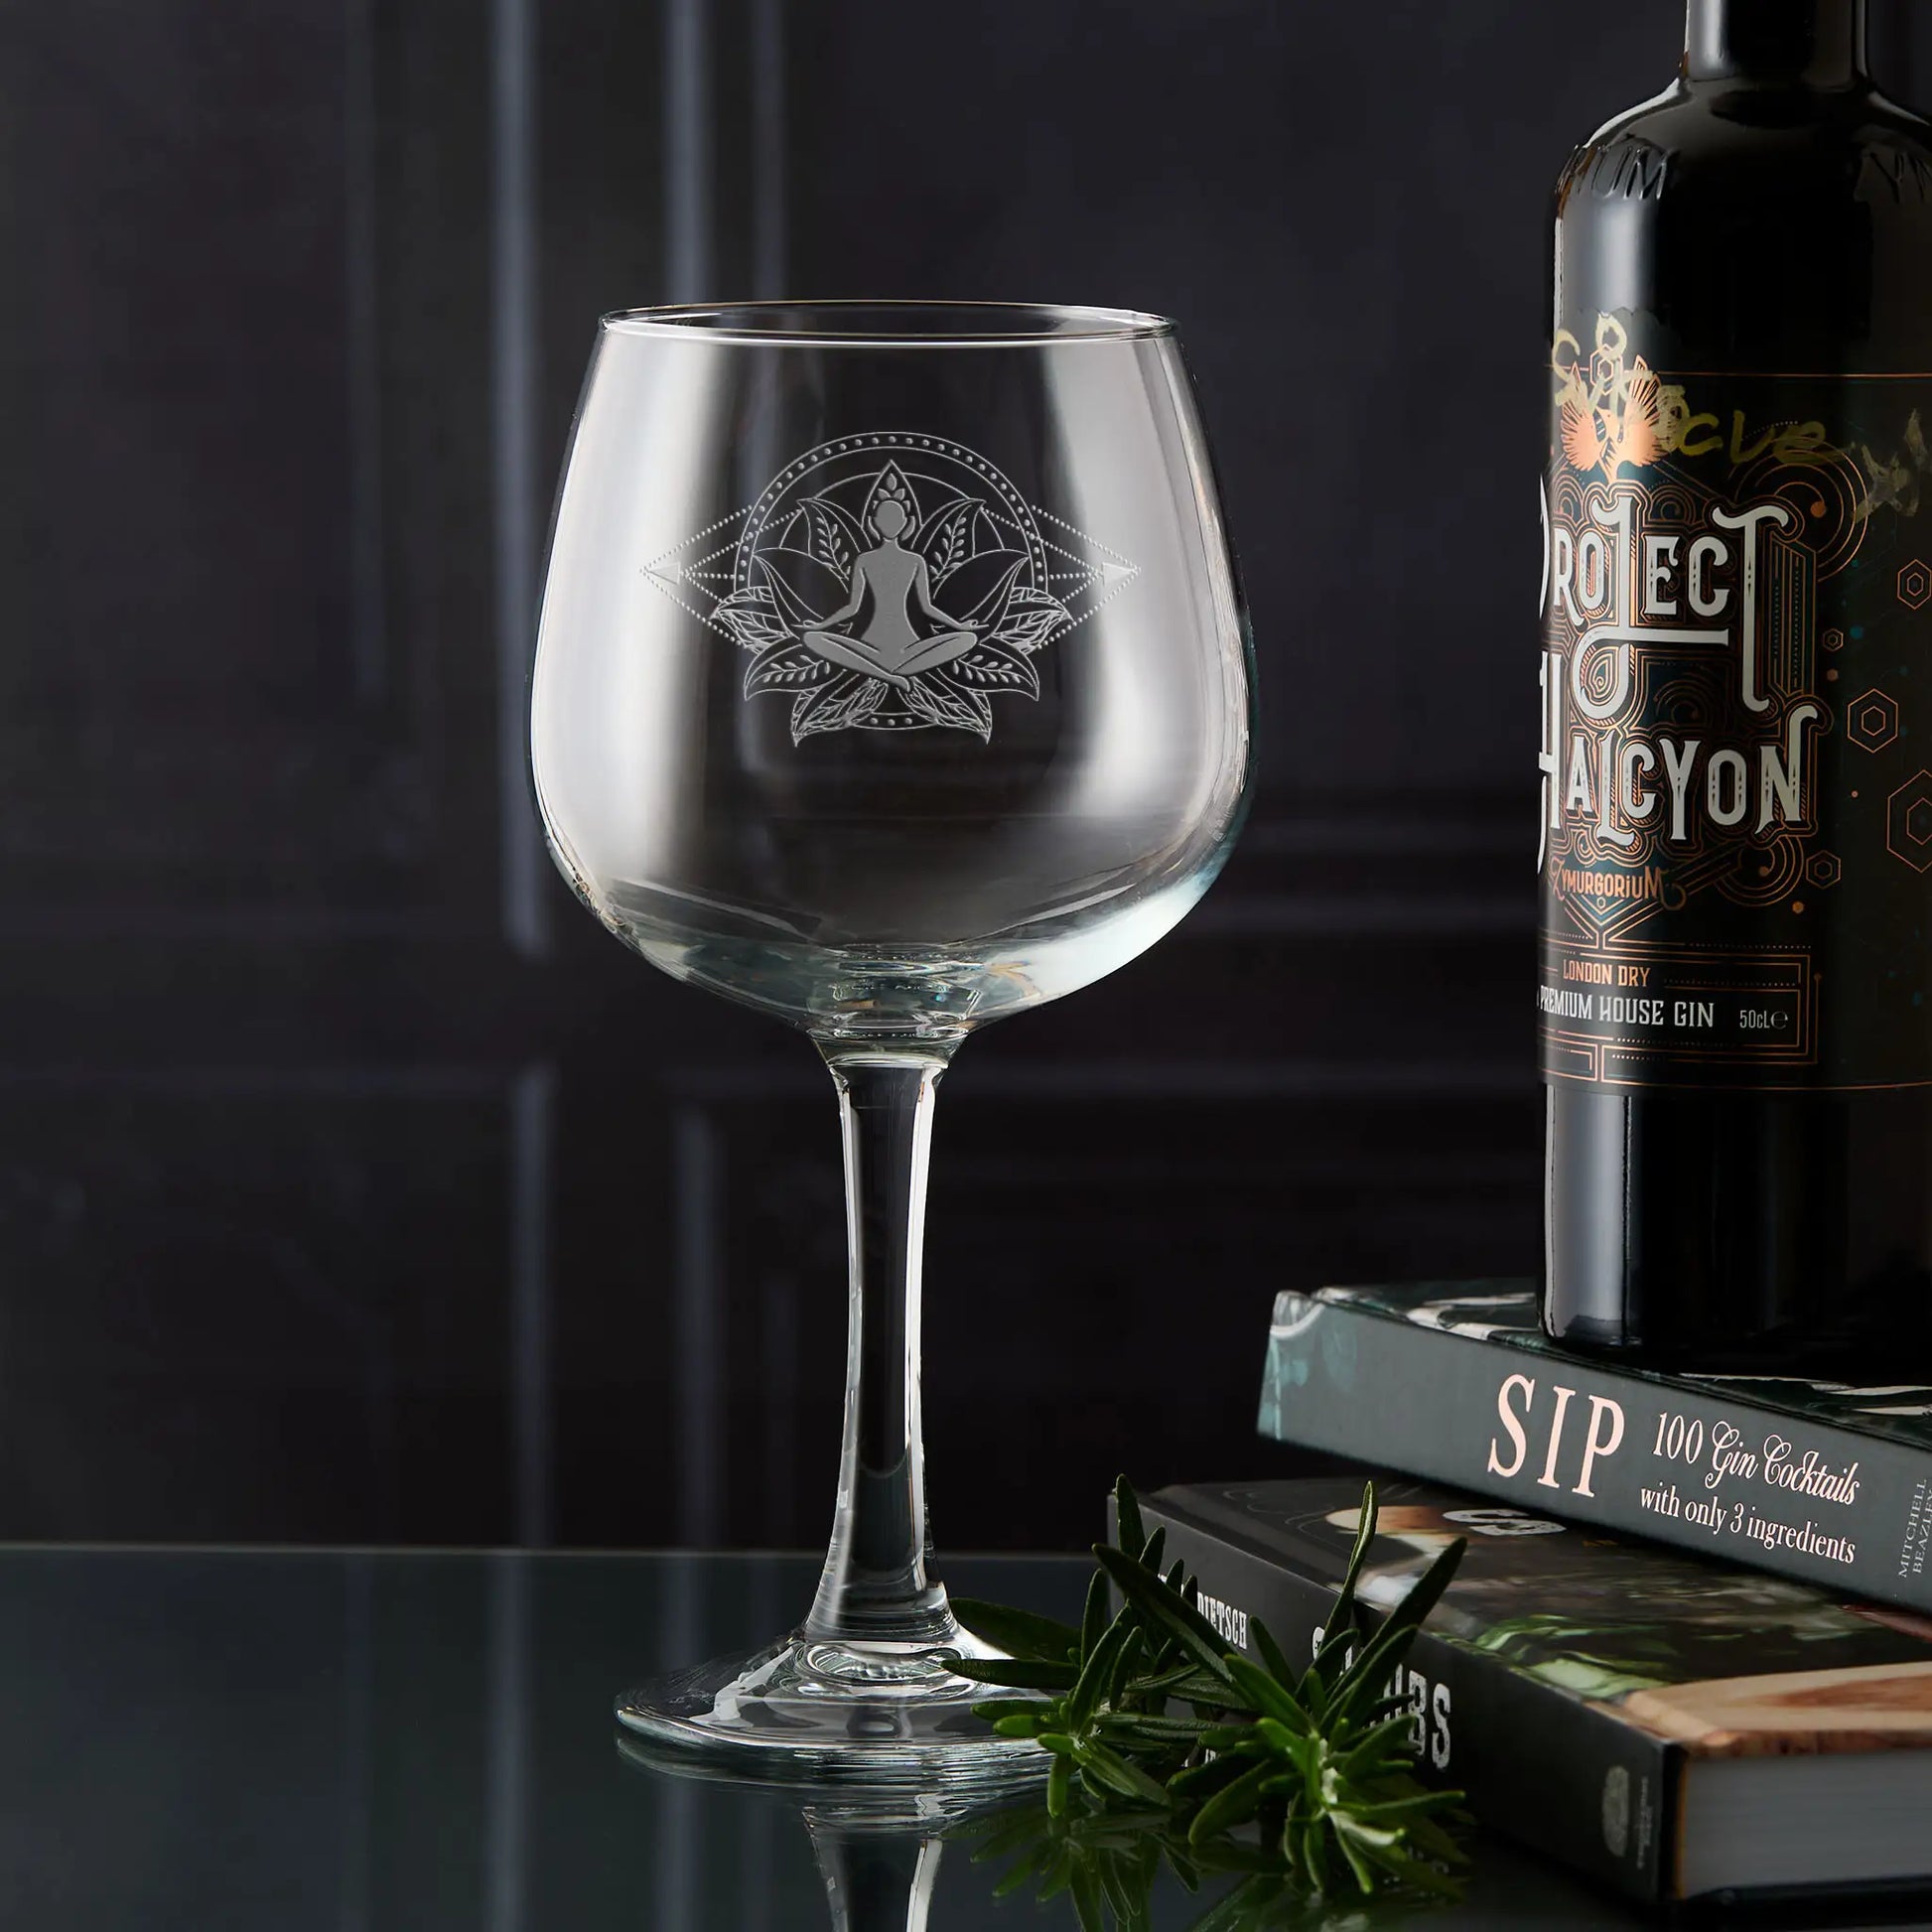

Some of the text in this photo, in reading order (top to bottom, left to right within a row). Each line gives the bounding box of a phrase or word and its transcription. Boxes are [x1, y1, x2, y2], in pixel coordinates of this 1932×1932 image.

[1540, 476, 1789, 720] ROJECT
[1538, 650, 1819, 874] HALCYON
[1540, 984, 1592, 1021] PREMIUM
[1598, 995, 1664, 1027] HOUSE
[1673, 1001, 1715, 1029] GIN
[1563, 958, 1651, 988] LONDON DRY
[1487, 1374, 1625, 1497] SIP
[1653, 1412, 1861, 1505] 100 Gin Cocktails
[1640, 1479, 1857, 1565] with only 3 ingredients
[1898, 1478, 1927, 1579] MITCHELL
